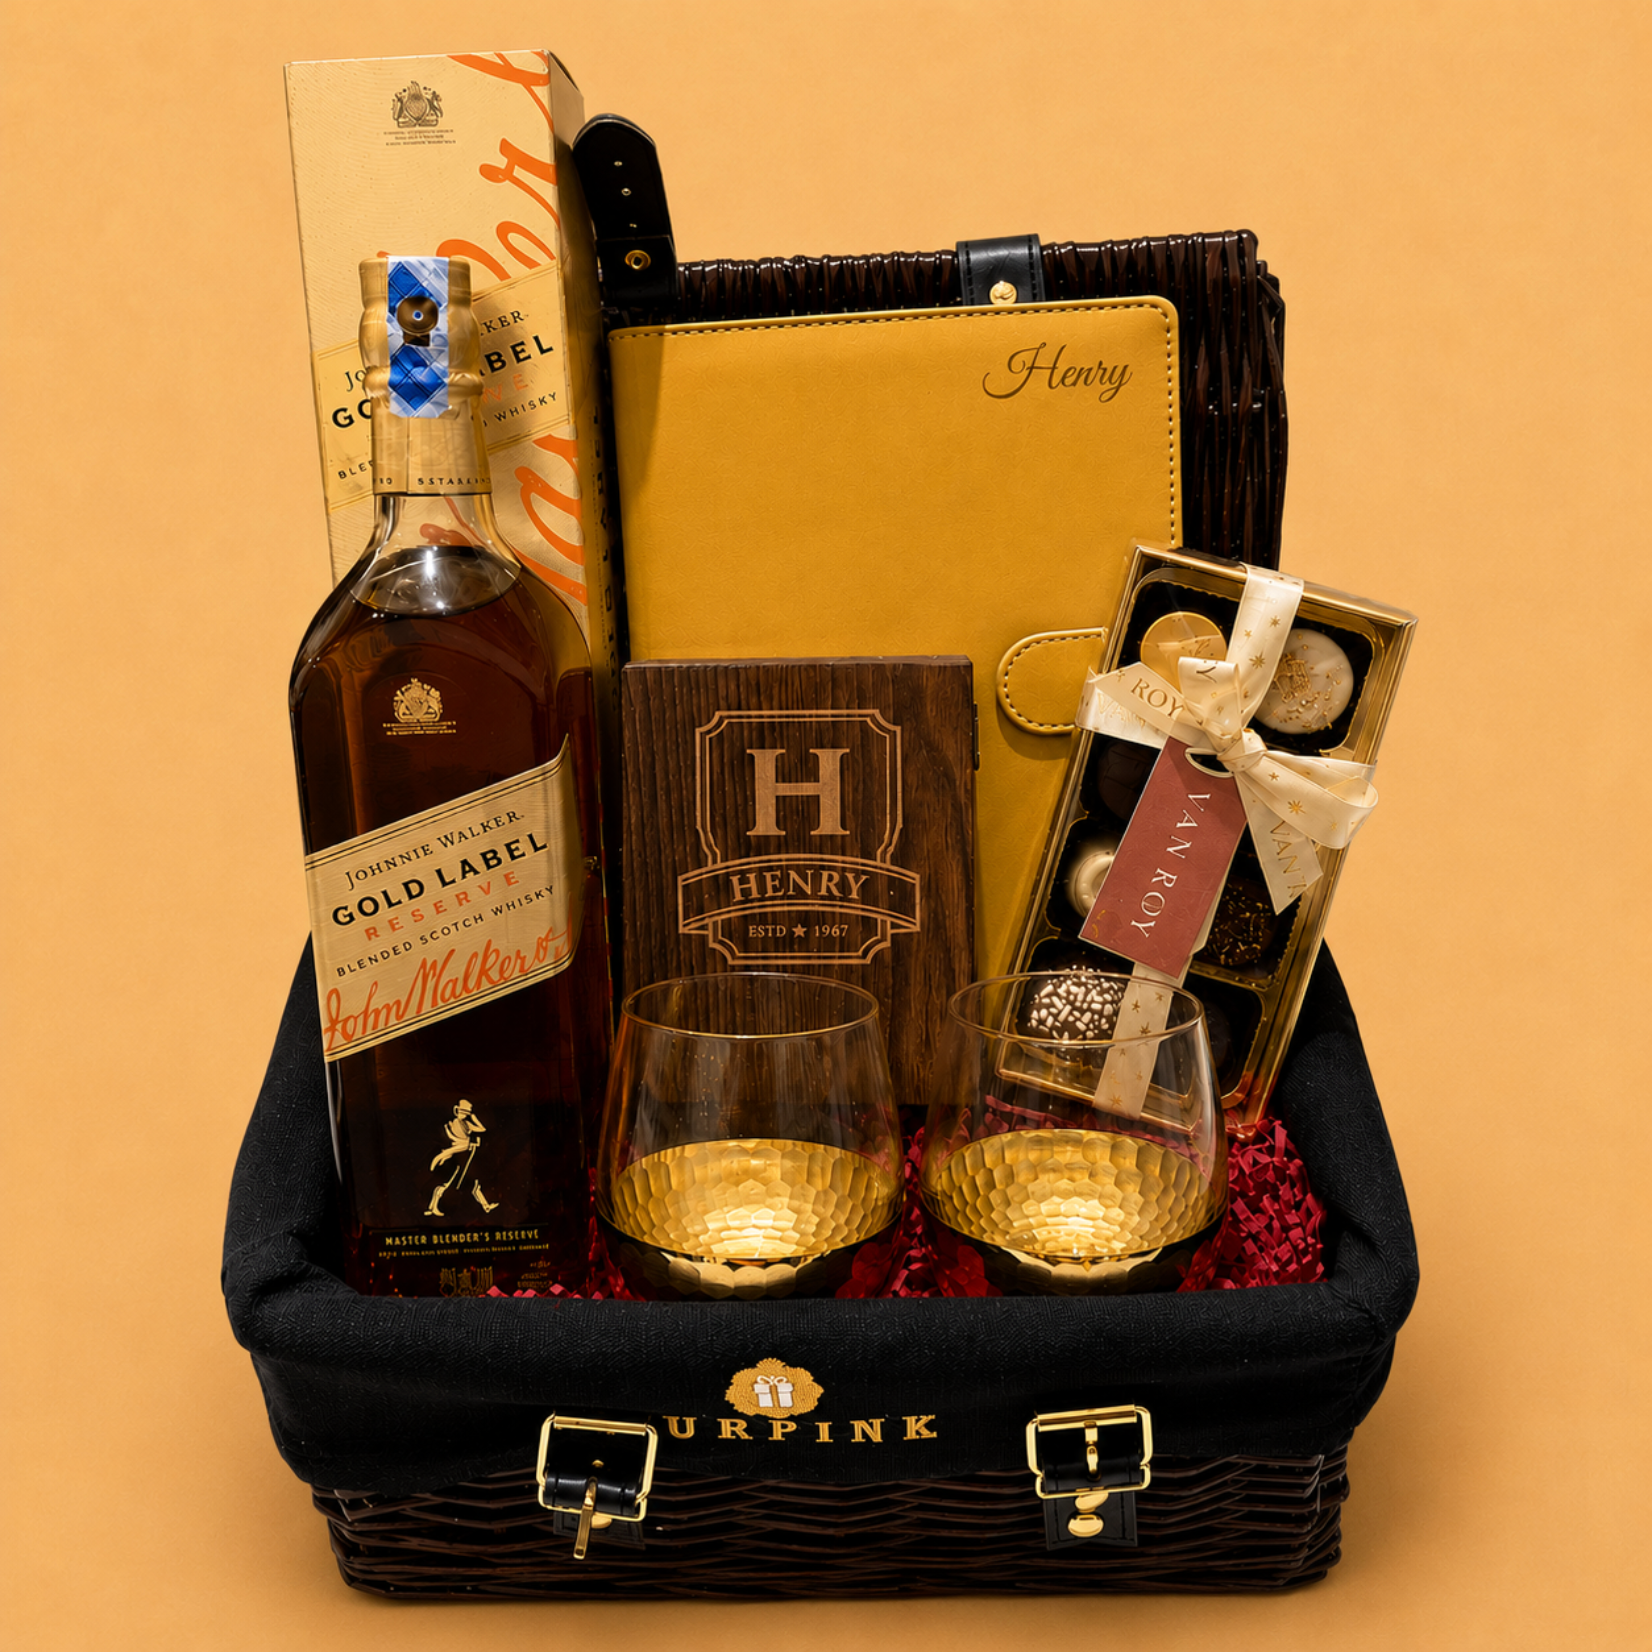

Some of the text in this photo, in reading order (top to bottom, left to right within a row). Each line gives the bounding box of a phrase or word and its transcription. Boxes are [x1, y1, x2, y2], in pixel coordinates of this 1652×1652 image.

[982, 342, 1134, 404] Henry
[494, 392, 557, 422] WHISKY
[1130, 677, 1185, 718] ROY
[746, 748, 850, 836] H
[331, 832, 549, 926] GOLD LABEL
[344, 843, 434, 890] JOHNNIE
[729, 869, 871, 903] HENRY
[1130, 793, 1212, 938] VAN ROY
[336, 885, 554, 977] BLENDED SCOTCH WHISKY
[364, 871, 520, 942] RESERVE
[748, 924, 850, 939] ESTD 1967
[385, 1228, 539, 1246] MASTER BLENDER'S RESERVE
